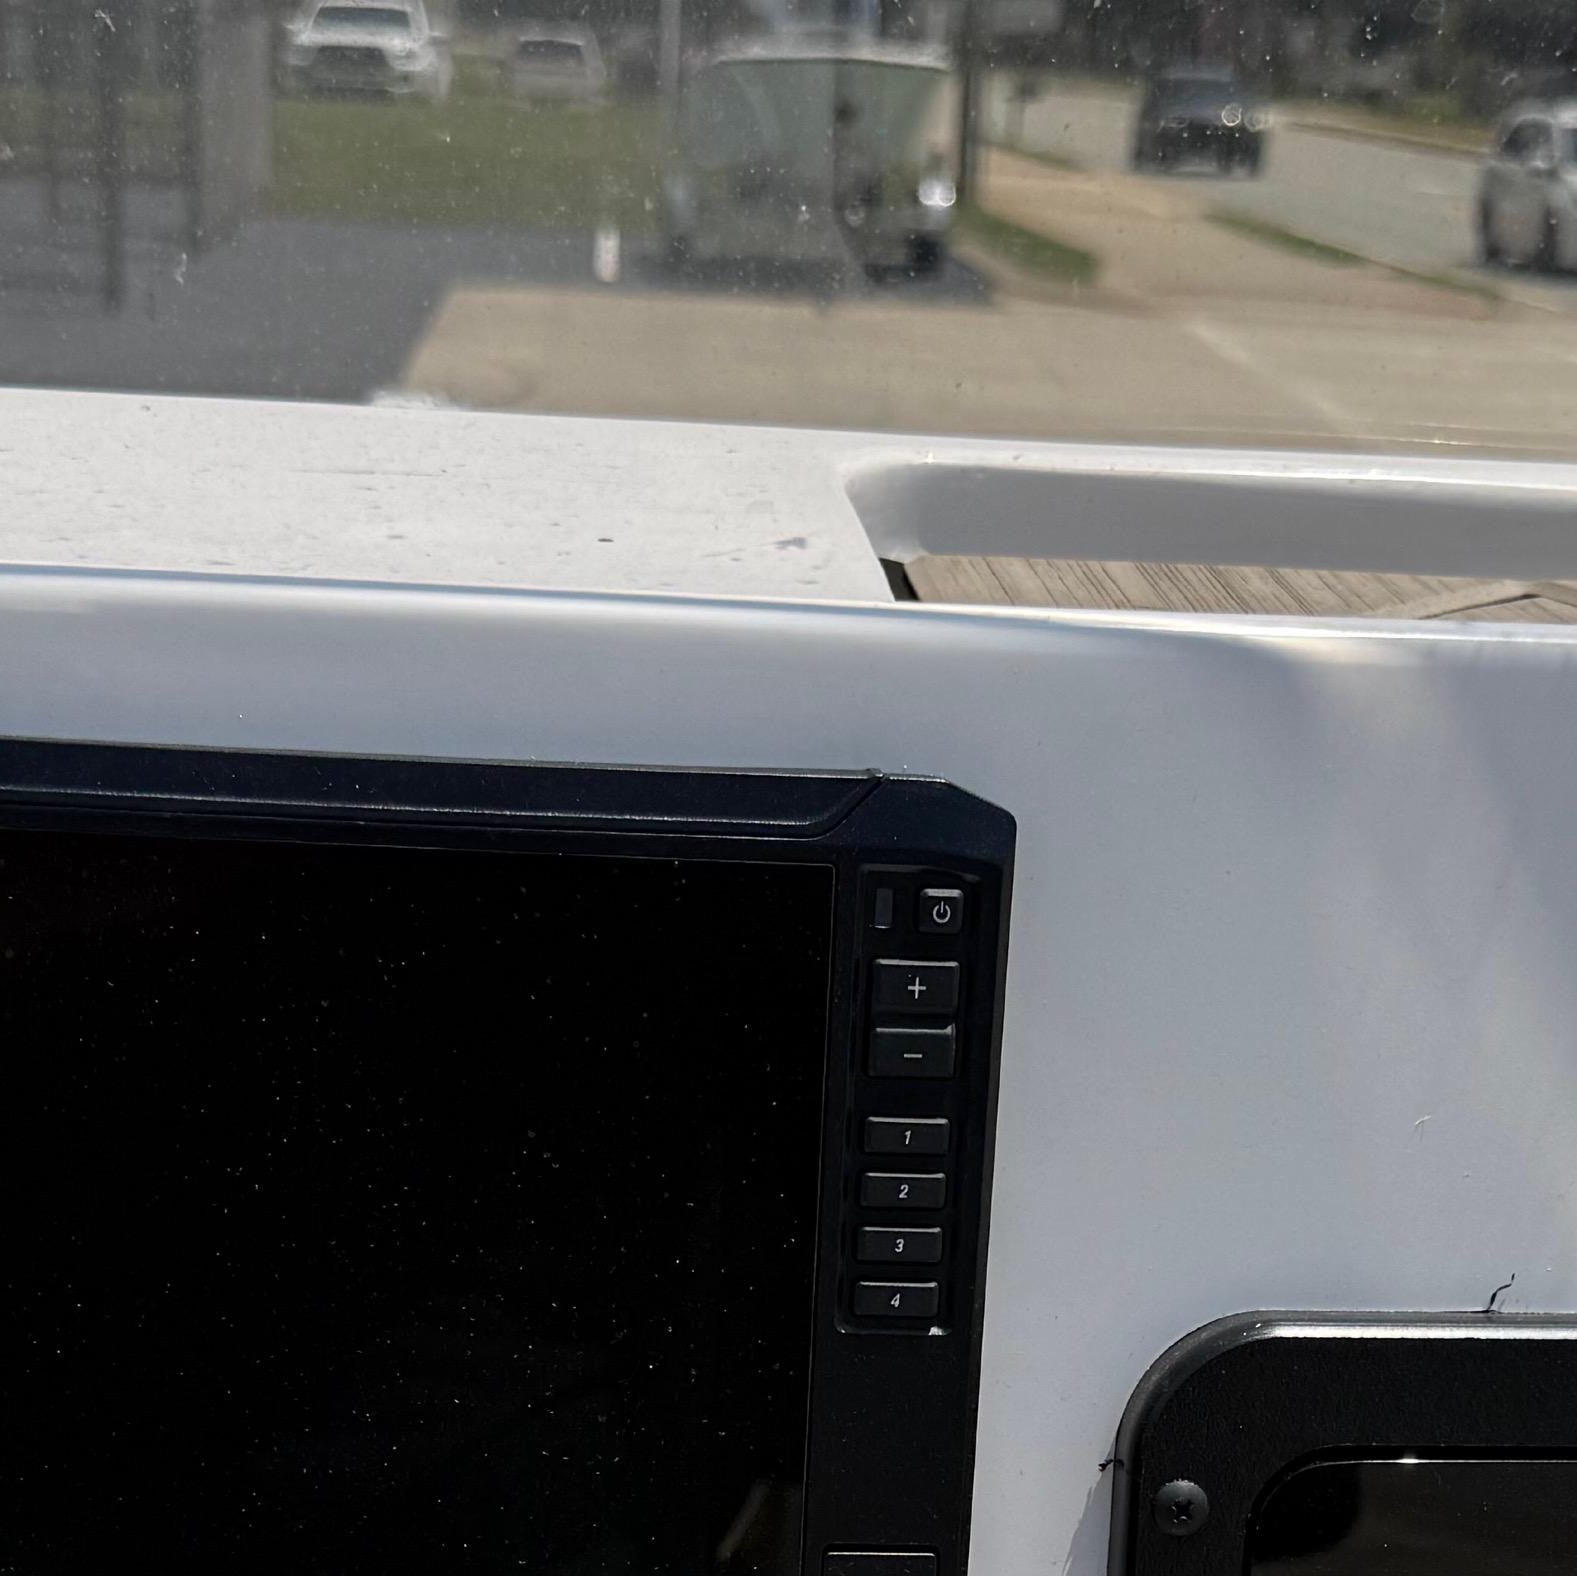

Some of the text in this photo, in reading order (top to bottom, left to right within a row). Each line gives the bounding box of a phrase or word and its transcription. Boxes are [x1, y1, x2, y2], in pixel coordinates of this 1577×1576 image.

[904, 1131, 912, 1144] 1
[899, 1185, 908, 1198] 2
[895, 1239, 904, 1252] 3
[891, 1293, 901, 1307] 4
